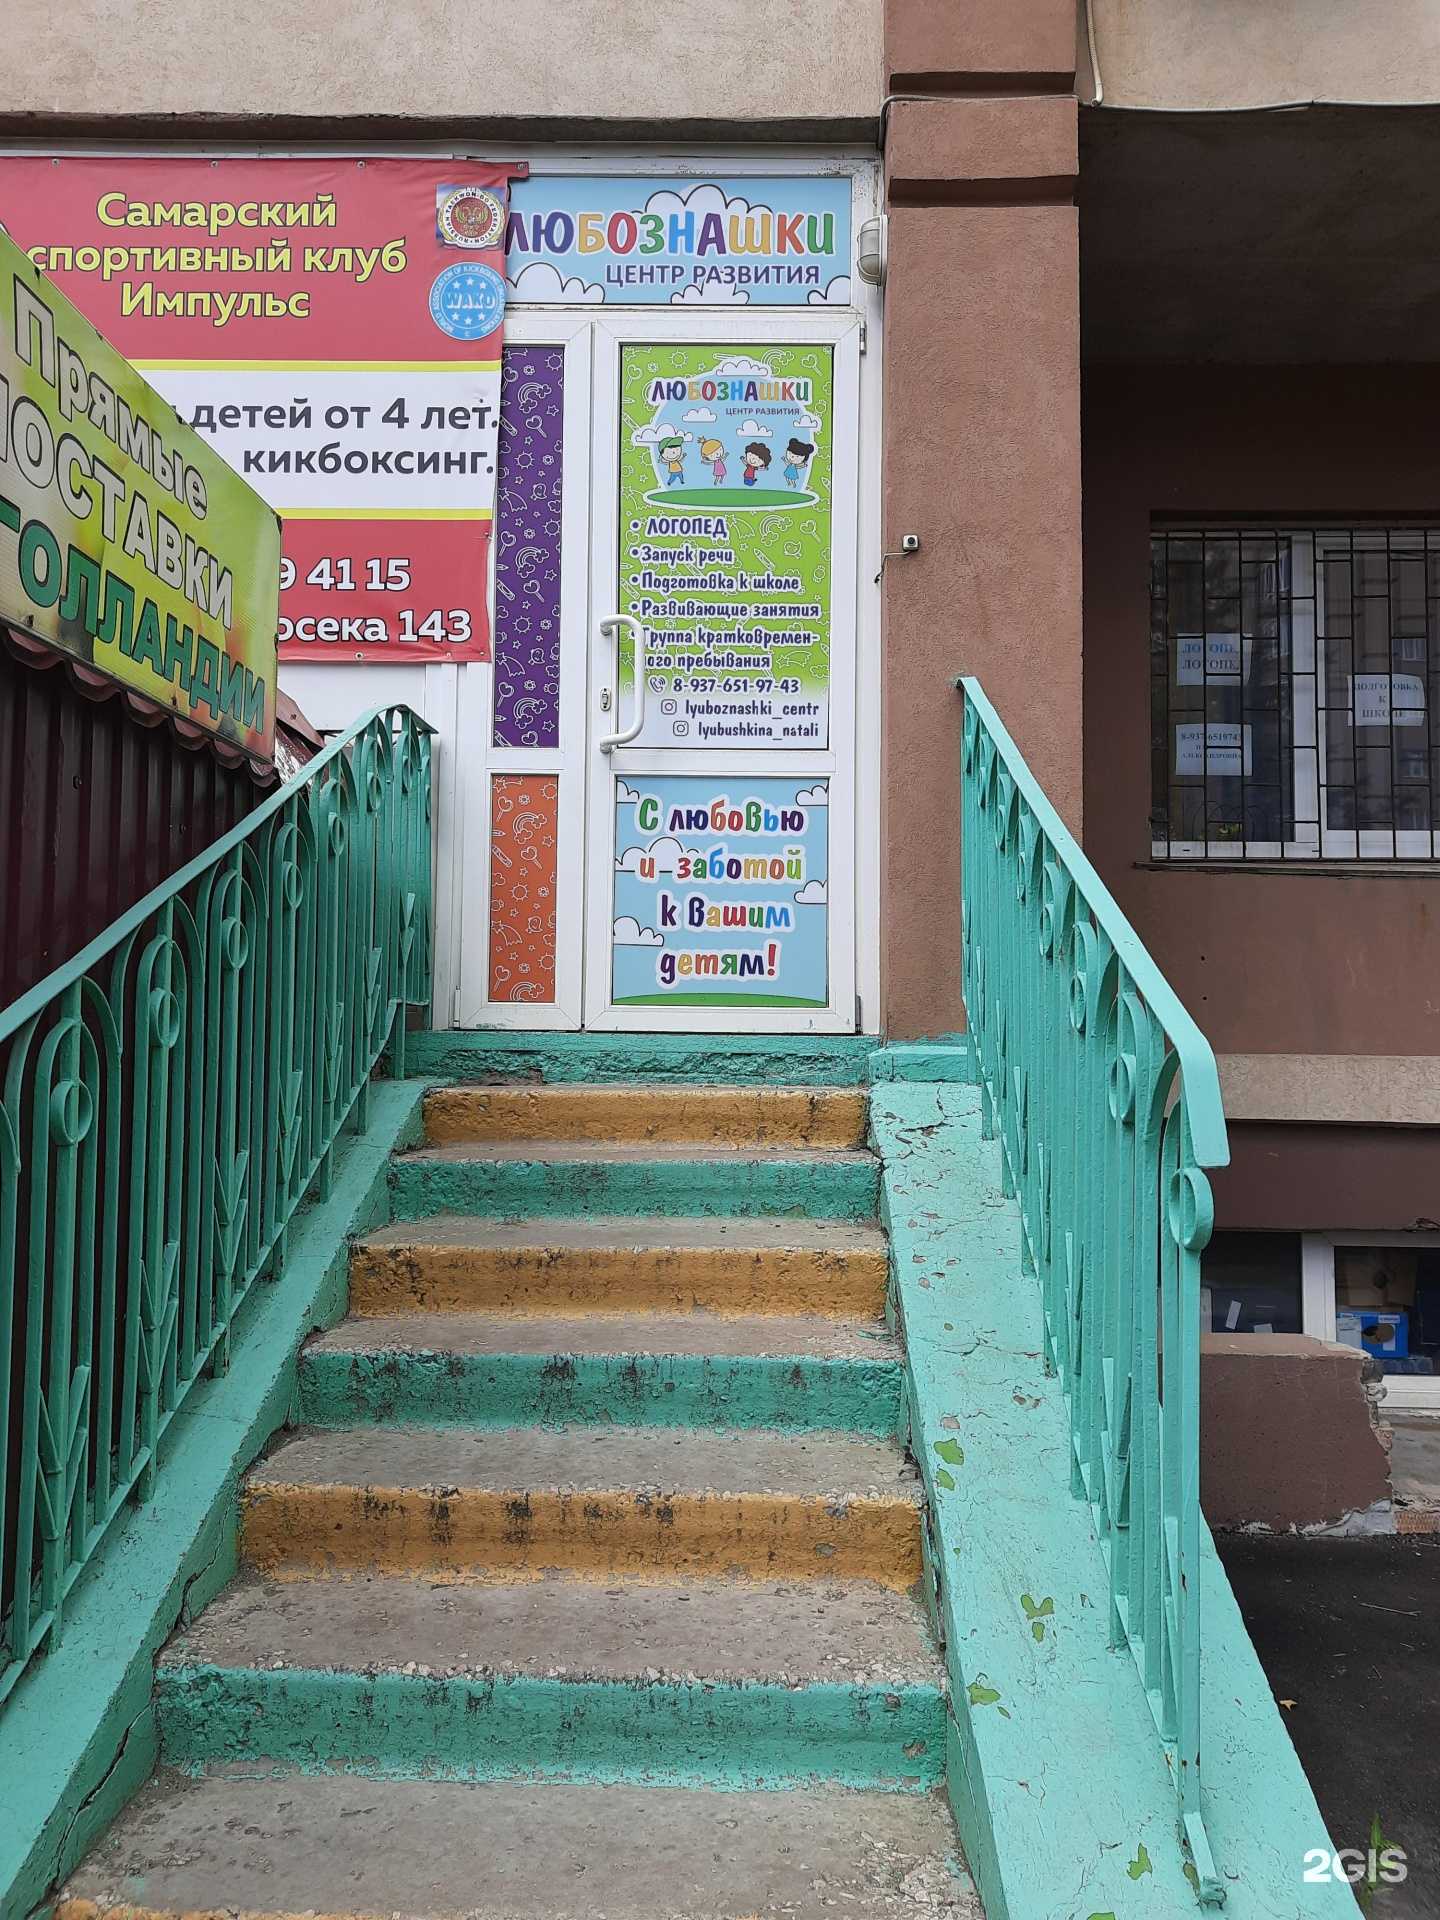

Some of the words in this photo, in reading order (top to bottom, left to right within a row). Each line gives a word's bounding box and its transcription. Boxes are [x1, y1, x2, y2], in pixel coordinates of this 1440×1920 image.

[96, 192, 337, 229] Самарский
[505, 211, 834, 256] ЛЮБОЗНАШКИ
[26, 238, 291, 280] спортивный
[304, 239, 407, 283] клуб
[606, 264, 684, 288] ЦЕНТР
[693, 264, 819, 286] РАЗВИТИЯ
[121, 282, 310, 326] Импульс
[13, 274, 208, 520] Прямые
[651, 380, 808, 402] ЛЮБОЗНАШКИ
[190, 398, 312, 433] детей
[325, 405, 370, 429] от
[381, 398, 409, 429] 4
[420, 405, 497, 429] лет.
[725, 408, 754, 417] ЦЕНТР
[756, 407, 800, 416] РАЗВИТИЯ
[243, 442, 494, 474] кикбоксинг.
[0, 373, 233, 629] ОСТАВКИ
[647, 517, 727, 539] ЛОГОПЕД
[641, 547, 694, 566] Запуск
[699, 550, 733, 566] речи
[306, 557, 356, 591] 41
[366, 557, 410, 591] 15
[642, 573, 734, 593] Подготовка
[739, 574, 749, 588] к
[753, 574, 799, 590] школе
[399, 608, 472, 643] 143
[641, 600, 748, 619] Развивающие
[753, 604, 819, 617] занятия
[699, 627, 818, 647] кратковремен-
[645, 655, 672, 667] ого
[677, 652, 770, 672] пребывания
[673, 678, 799, 693] 8-937-651-97-43
[685, 700, 819, 719] lyuboznashki_centr
[699, 722, 819, 741] lyubushkina_natali
[669, 799, 804, 832] любовью
[640, 857, 655, 878] и
[677, 848, 802, 880] заботой
[660, 944, 777, 984] детям!
